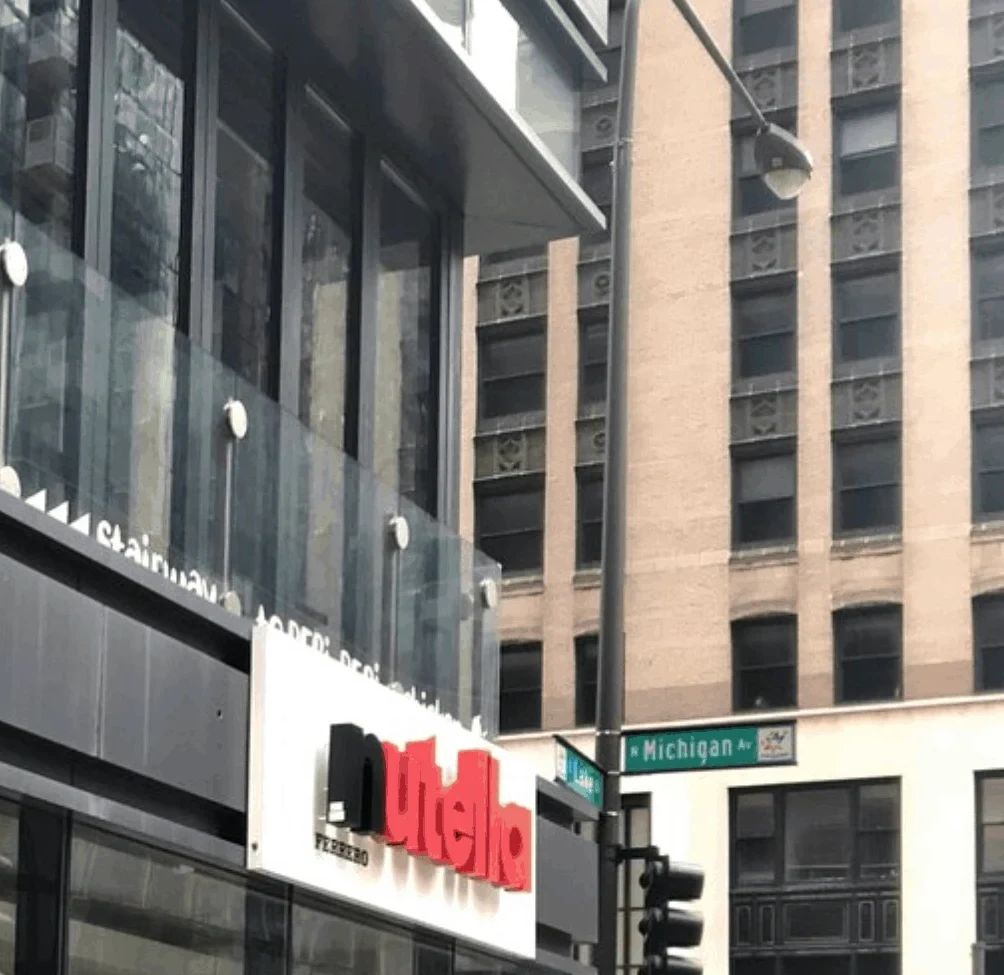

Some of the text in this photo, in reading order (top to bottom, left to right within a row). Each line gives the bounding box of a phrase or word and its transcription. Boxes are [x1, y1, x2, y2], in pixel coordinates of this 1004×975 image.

[643, 735, 733, 766] Michigan
[326, 722, 533, 892] nutella
[313, 832, 369, 867] FERRERO
